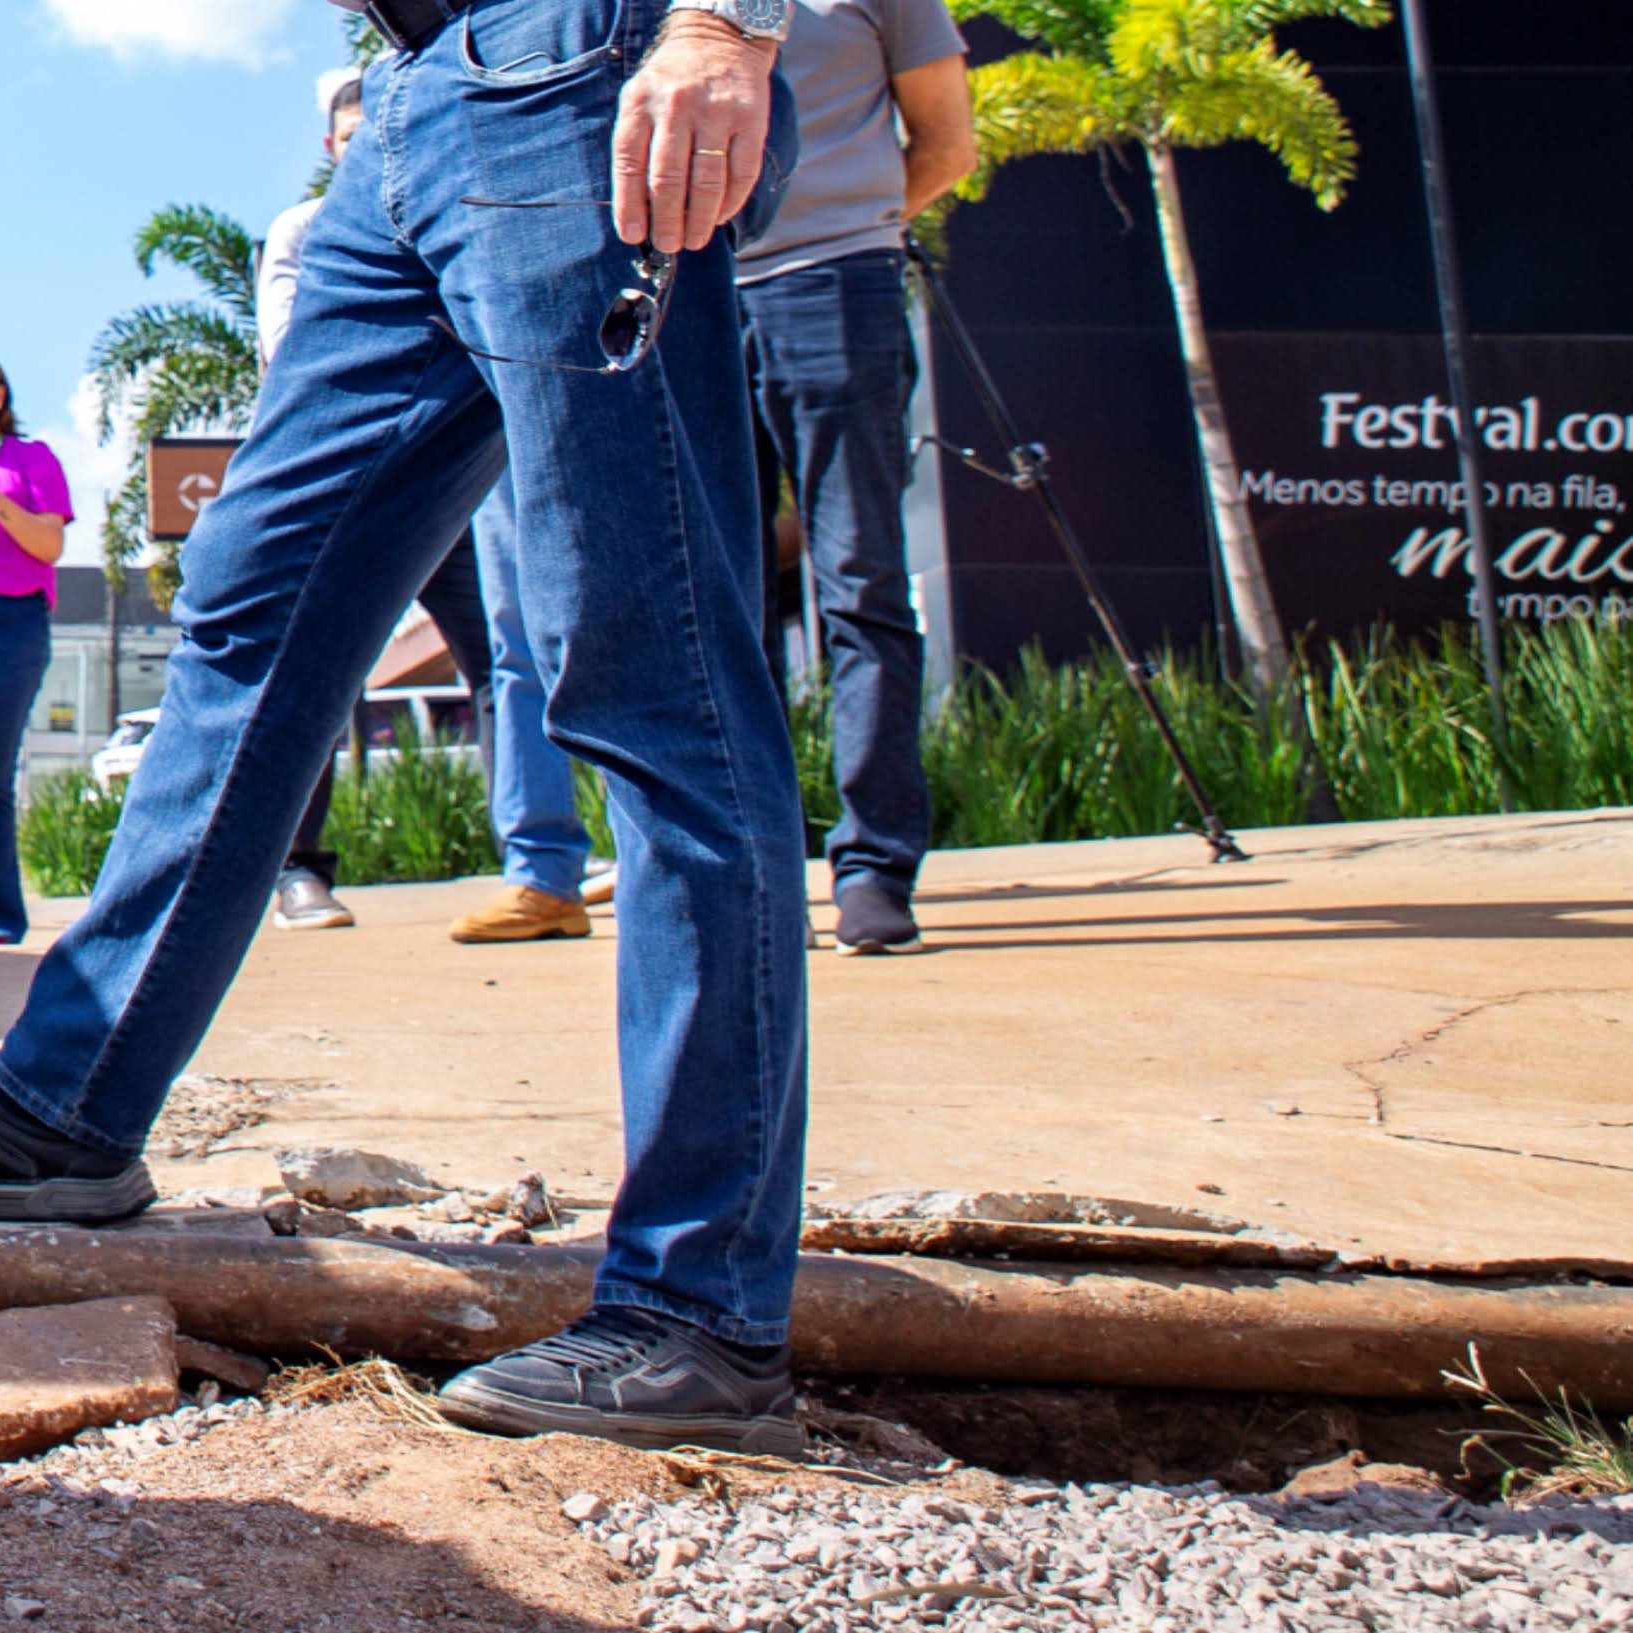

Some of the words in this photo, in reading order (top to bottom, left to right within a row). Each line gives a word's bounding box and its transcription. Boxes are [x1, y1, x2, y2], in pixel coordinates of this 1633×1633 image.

[1239, 469, 1367, 507] Menos
[1506, 481, 1554, 510] na
[1561, 473, 1627, 514] fila,
[1465, 586, 1594, 626] tmpo
